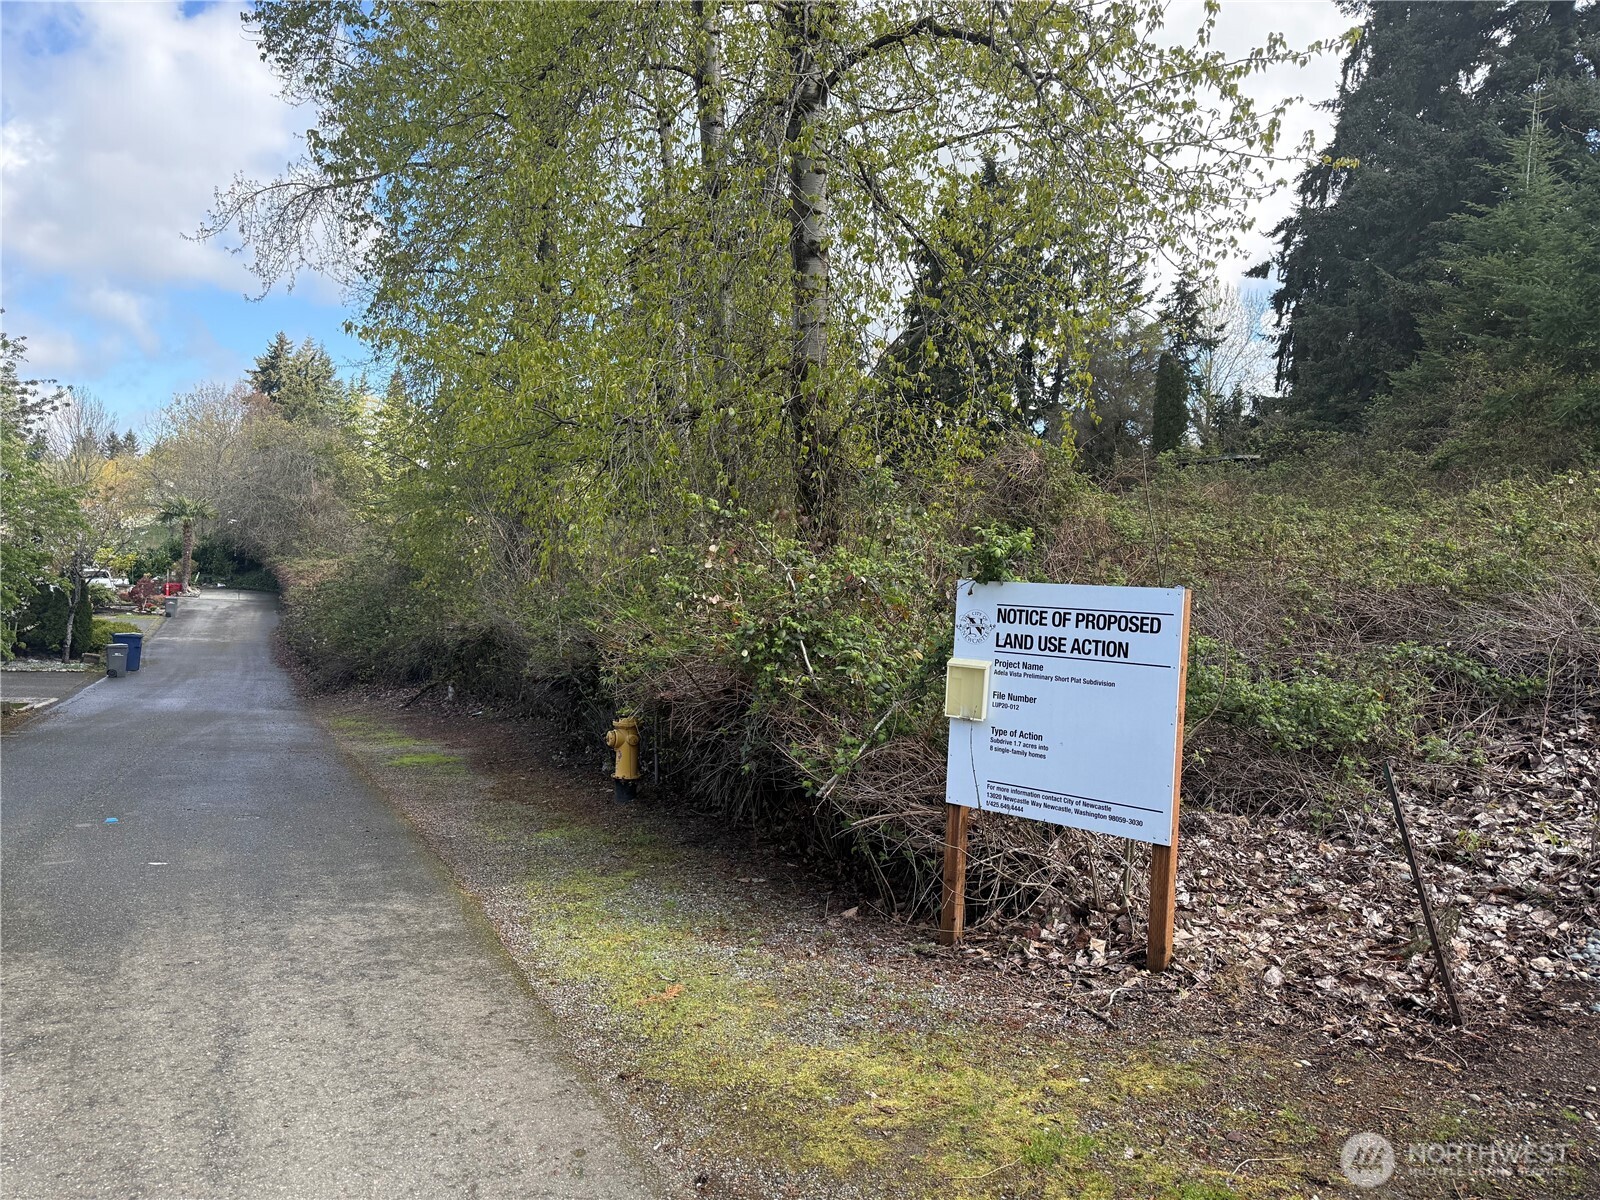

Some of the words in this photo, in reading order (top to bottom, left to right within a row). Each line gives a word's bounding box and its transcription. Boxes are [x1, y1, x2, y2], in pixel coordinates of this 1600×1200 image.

[997, 608, 1048, 627] NOTICE
[1052, 611, 1072, 628] OF
[1075, 612, 1162, 635] PROPOSED
[995, 632, 1034, 650] LAND
[1038, 636, 1067, 654] USE
[1070, 639, 1130, 659] ACTION
[994, 659, 1020, 669] Project
[1022, 661, 1044, 671] Name
[1023, 672, 1053, 682] Preliminary
[1054, 675, 1070, 683] Short
[1082, 678, 1116, 688] Subdivision
[992, 691, 1006, 700] File
[1007, 692, 1037, 704] Number
[992, 702, 1019, 711] LUP20-012
[991, 726, 1008, 737] Type
[1009, 730, 1017, 738] of
[1018, 730, 1043, 741] Action
[990, 737, 1012, 746] Subdrive
[994, 746, 1027, 757] single-family
[1028, 751, 1046, 759] homes
[1010, 788, 1040, 798] information
[1041, 794, 1062, 802] contact
[1063, 797, 1074, 806] City
[1082, 801, 1112, 812] Newcastle
[1002, 795, 1030, 806] Newcastle
[1030, 800, 1042, 808] Way
[1043, 803, 1073, 814] Newcastle,
[1074, 808, 1107, 819] Washington
[1108, 814, 1143, 827] 98059-3030
